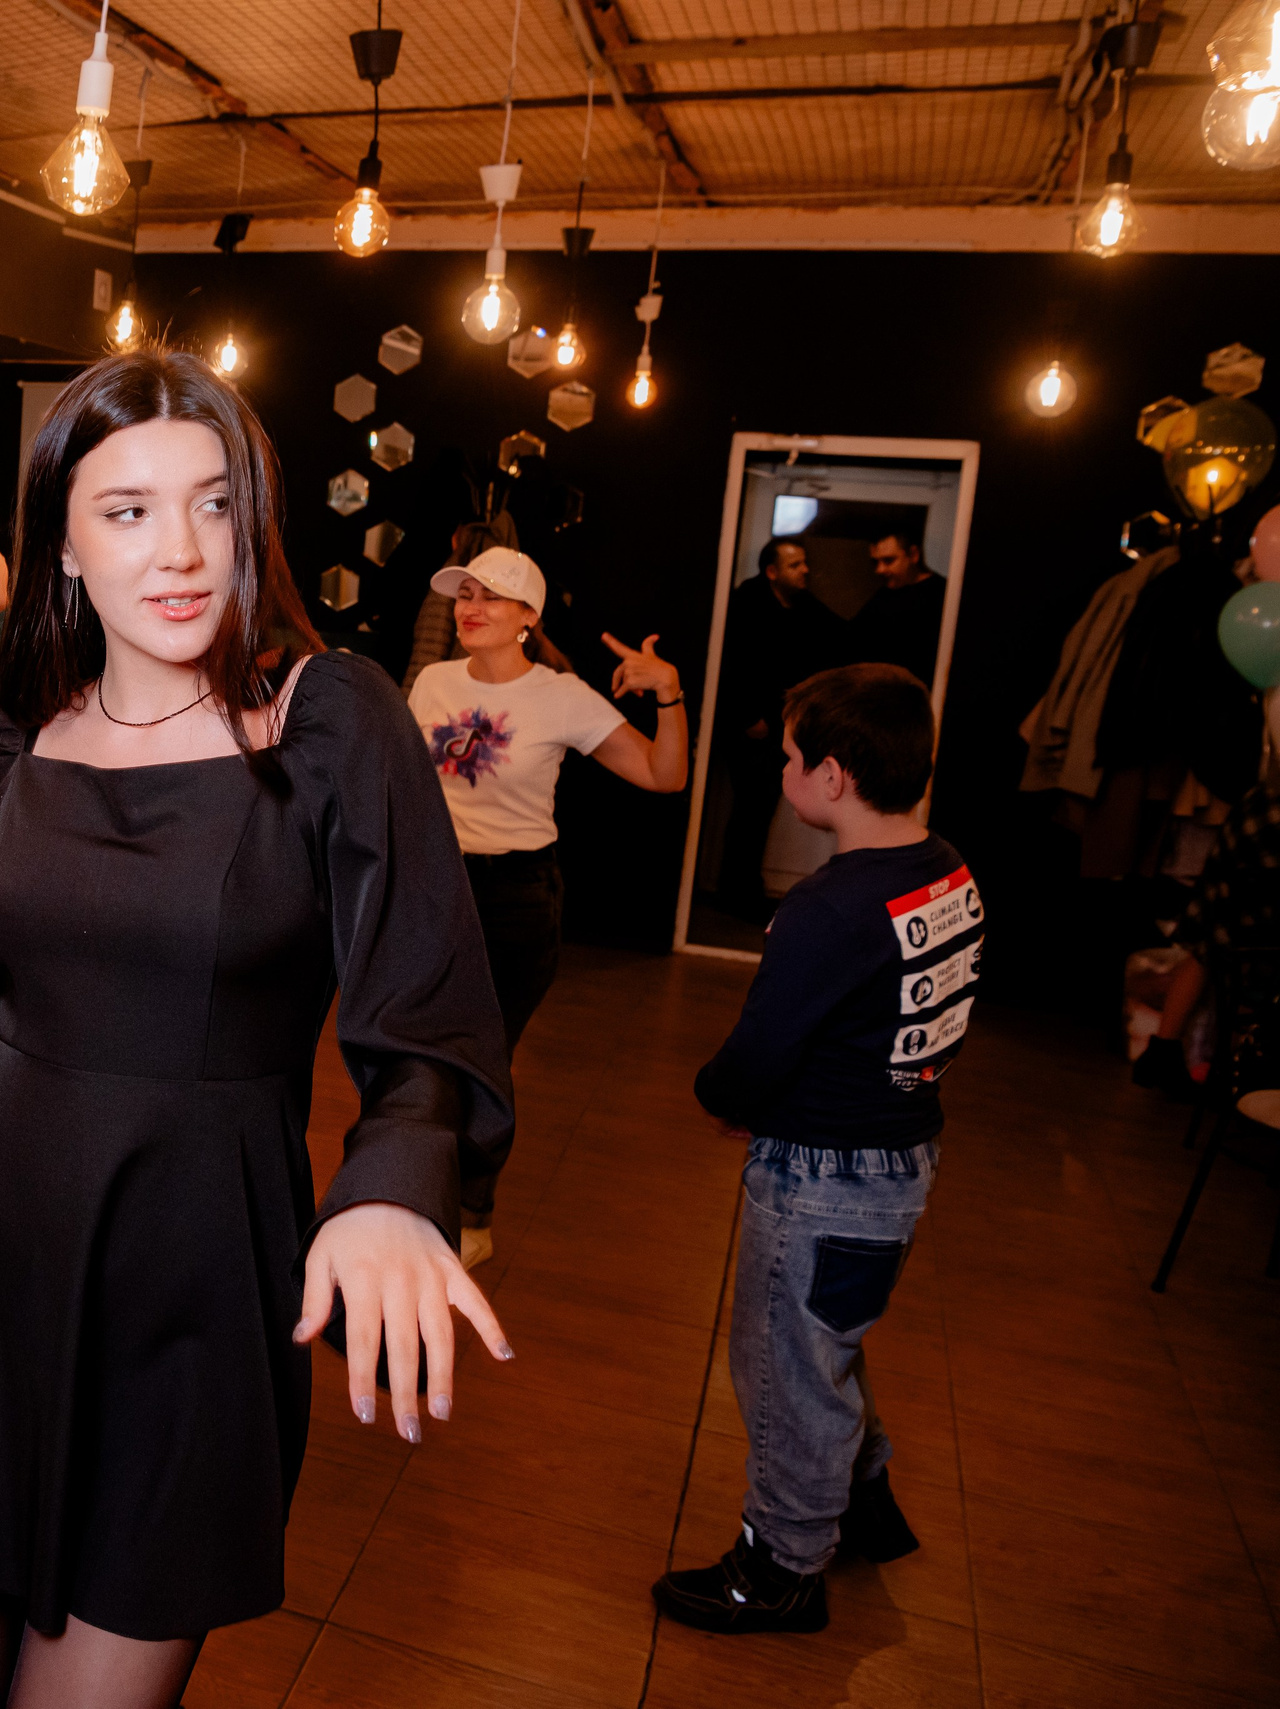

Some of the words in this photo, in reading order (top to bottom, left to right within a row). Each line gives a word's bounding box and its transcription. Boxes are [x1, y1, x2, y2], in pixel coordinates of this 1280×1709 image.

[928, 879, 950, 899] STOP
[930, 899, 961, 922] CLIMATE
[932, 912, 963, 935] CHANGE
